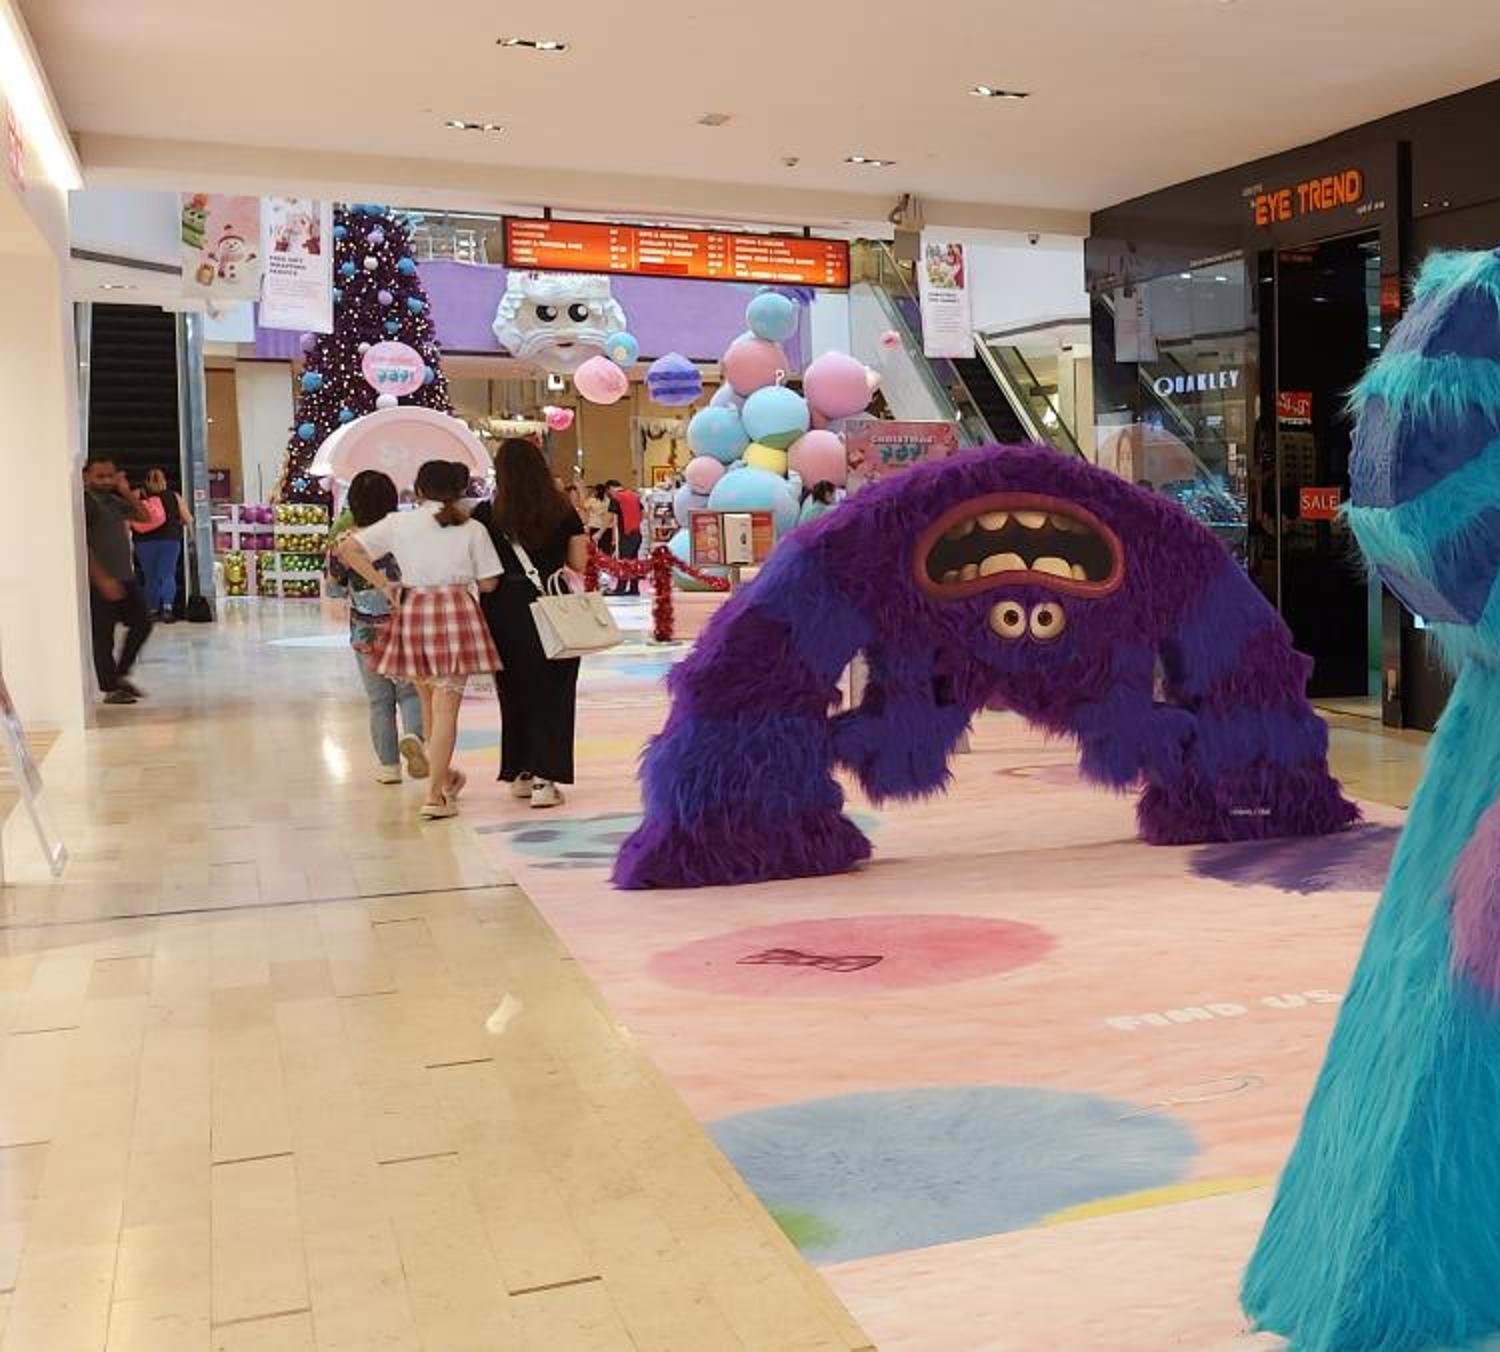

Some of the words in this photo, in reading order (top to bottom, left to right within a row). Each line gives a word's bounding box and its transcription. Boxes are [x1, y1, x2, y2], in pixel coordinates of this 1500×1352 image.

[1255, 188, 1293, 225] EYE
[1297, 169, 1362, 214] TREND
[1301, 495, 1338, 511] SALE
[1105, 1002, 1249, 1031] FIND
[1262, 989, 1344, 1009] US
